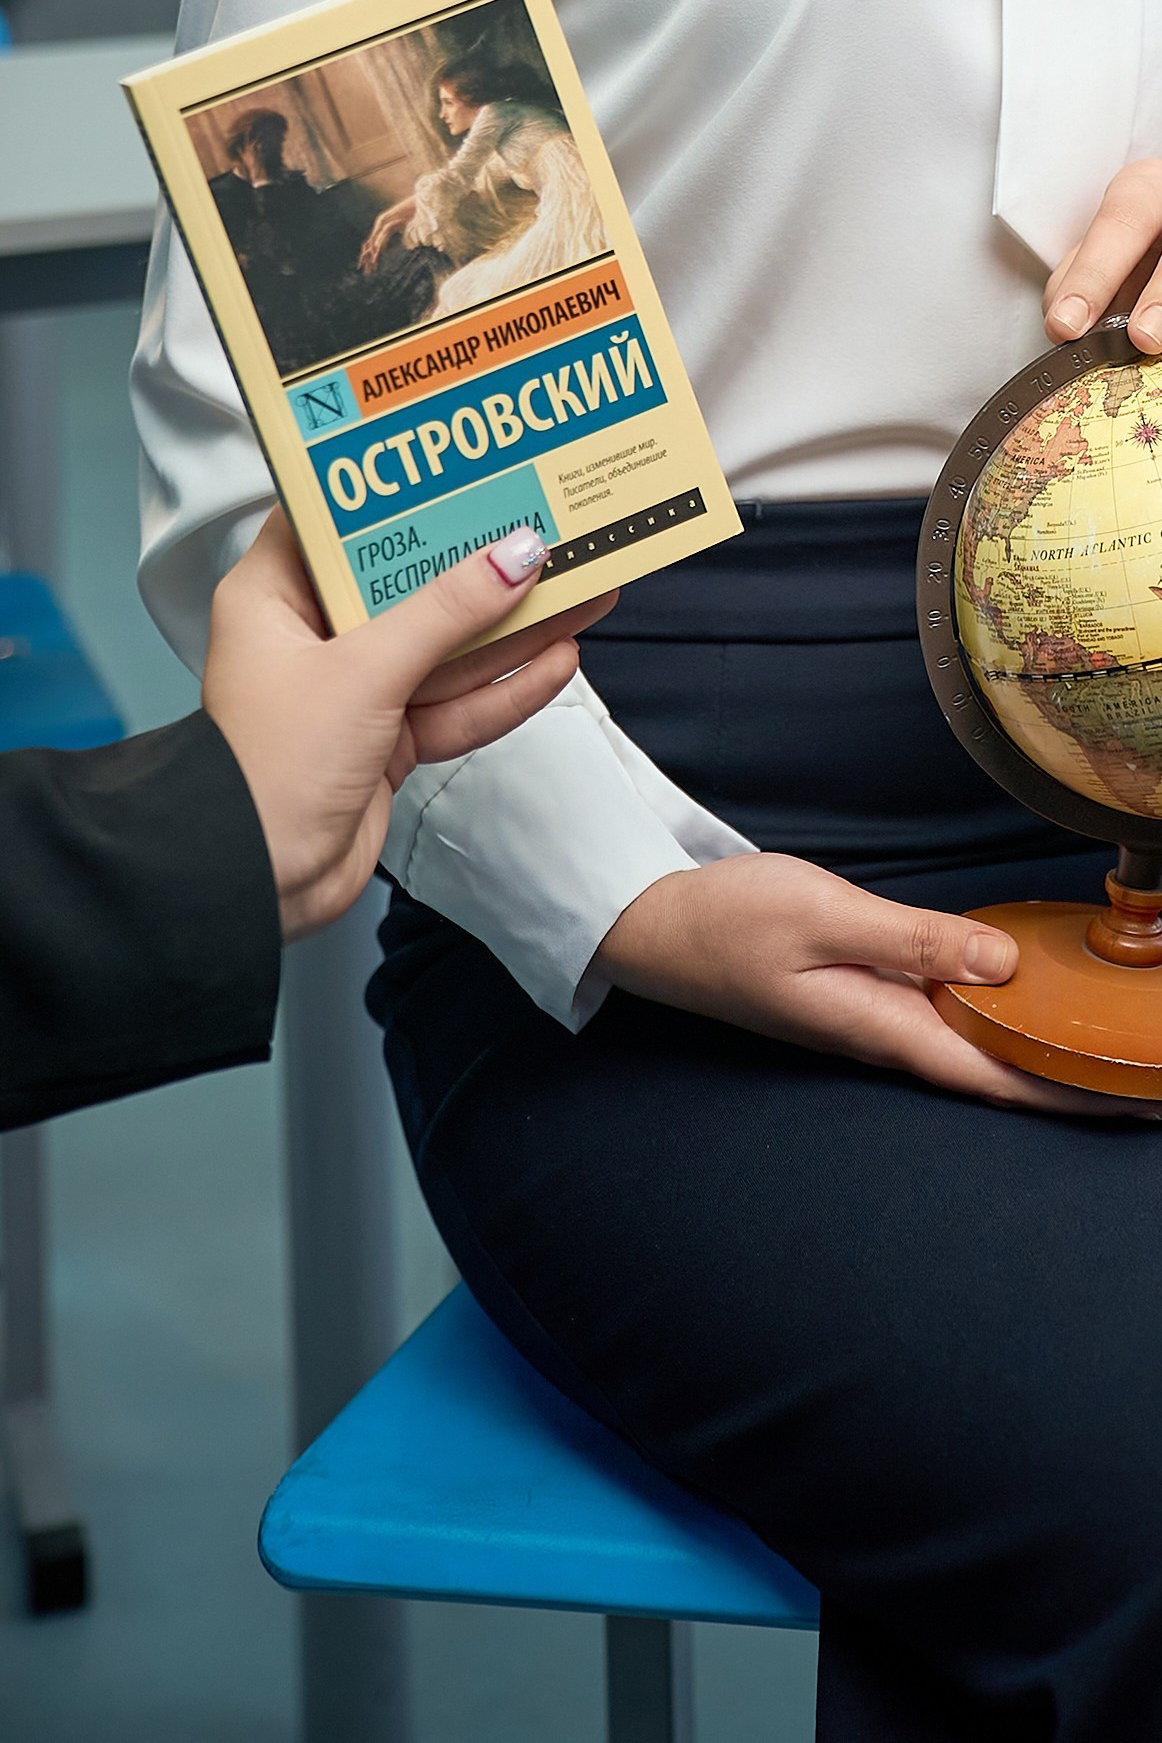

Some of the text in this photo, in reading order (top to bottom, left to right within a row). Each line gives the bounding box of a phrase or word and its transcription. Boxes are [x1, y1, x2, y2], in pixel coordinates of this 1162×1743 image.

[362, 279, 621, 402] АЛЕКСАНДР НИКОЛАЕВИЧ
[1070, 349, 1093, 369] 80
[1031, 372, 1053, 393] 70
[328, 330, 653, 511] ОСТРОВСКИЙ
[998, 401, 1018, 424] 60
[557, 438, 658, 484] Книги, изменившие мир.
[968, 437, 990, 461] 50
[1011, 454, 1045, 465] AMERICA
[563, 448, 668, 498] Писатели, объединившие
[948, 475, 966, 499] 40
[568, 487, 614, 512] поколения.
[932, 519, 950, 543] 30
[357, 526, 427, 572] ГРОЗА.
[1030, 547, 1075, 562] NORTH
[1080, 531, 1152, 557] ATLANTIC
[927, 561, 943, 584] 20
[927, 610, 942, 629] 10
[937, 657, 950, 669] 0
[1104, 696, 1161, 711] AMERICA
[1106, 708, 1154, 721] BRAZIL
